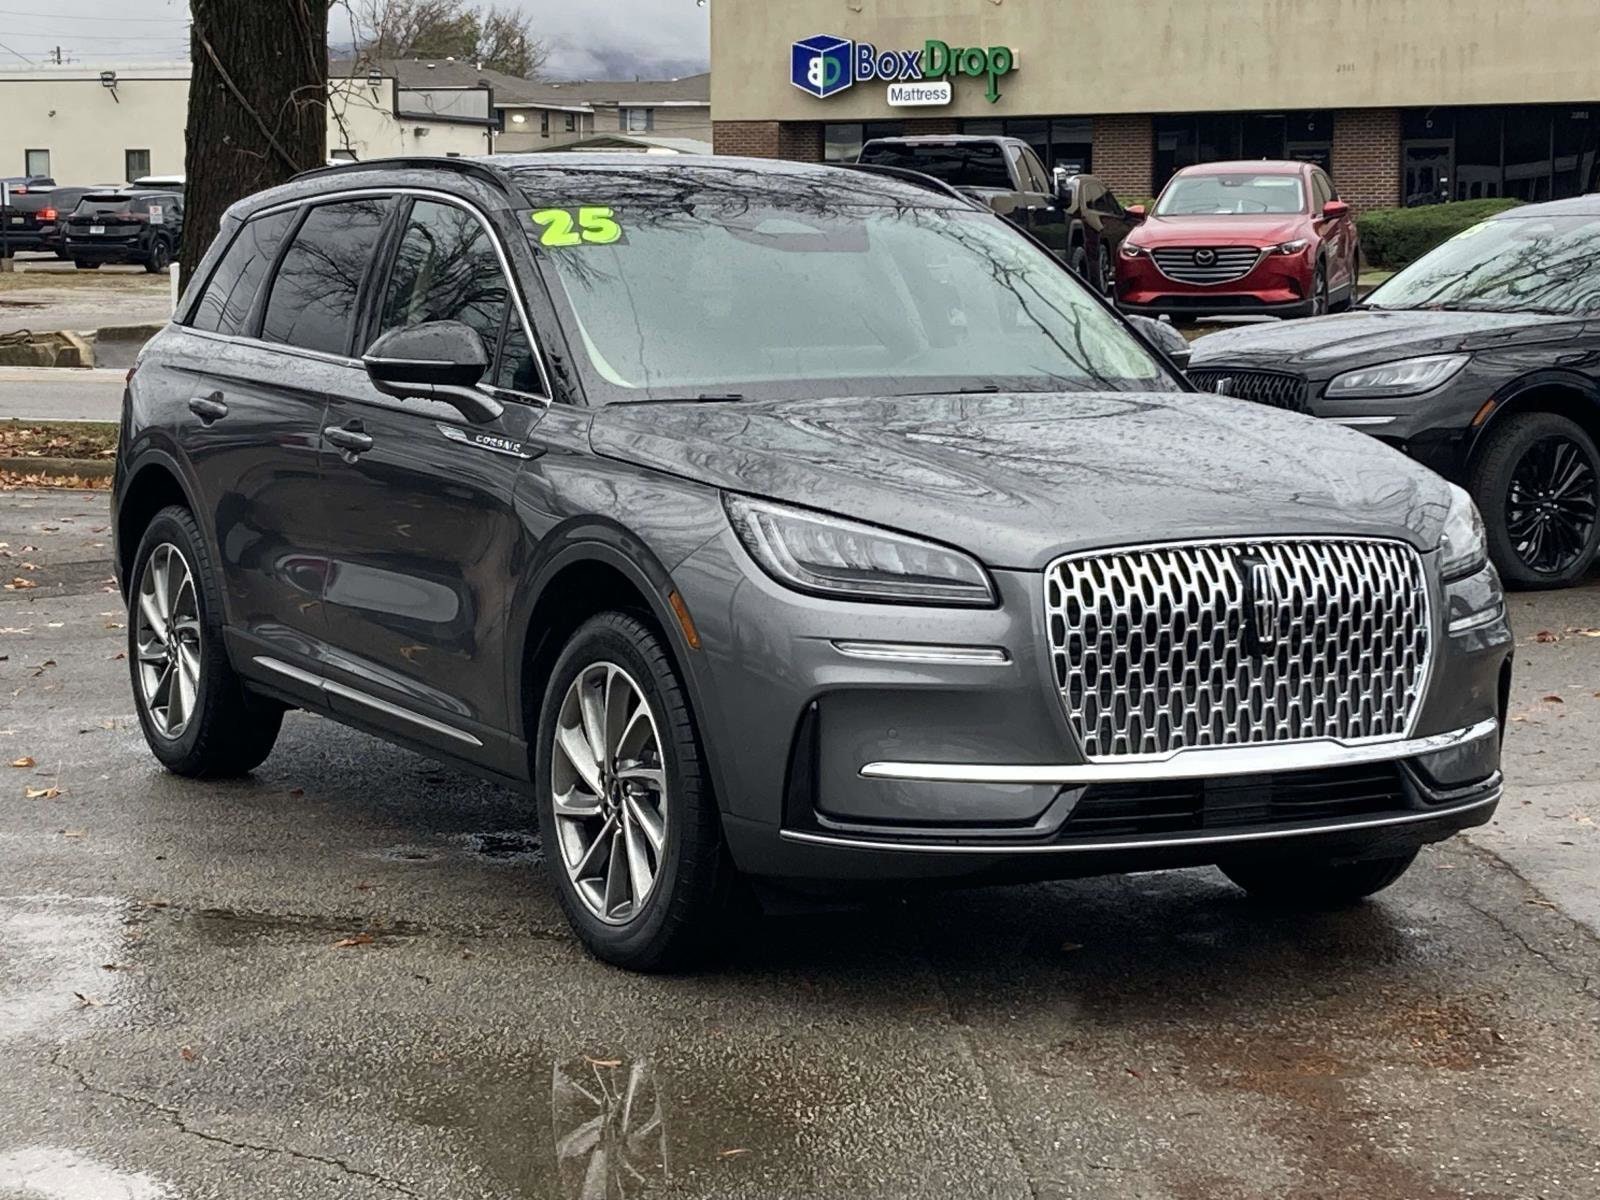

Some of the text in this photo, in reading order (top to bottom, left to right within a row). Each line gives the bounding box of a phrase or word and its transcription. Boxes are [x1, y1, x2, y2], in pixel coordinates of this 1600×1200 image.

[855, 40, 1013, 103] BoxDrop
[890, 86, 948, 102] Mattress
[532, 207, 622, 247] 25
[475, 434, 521, 452] CORSAIR
